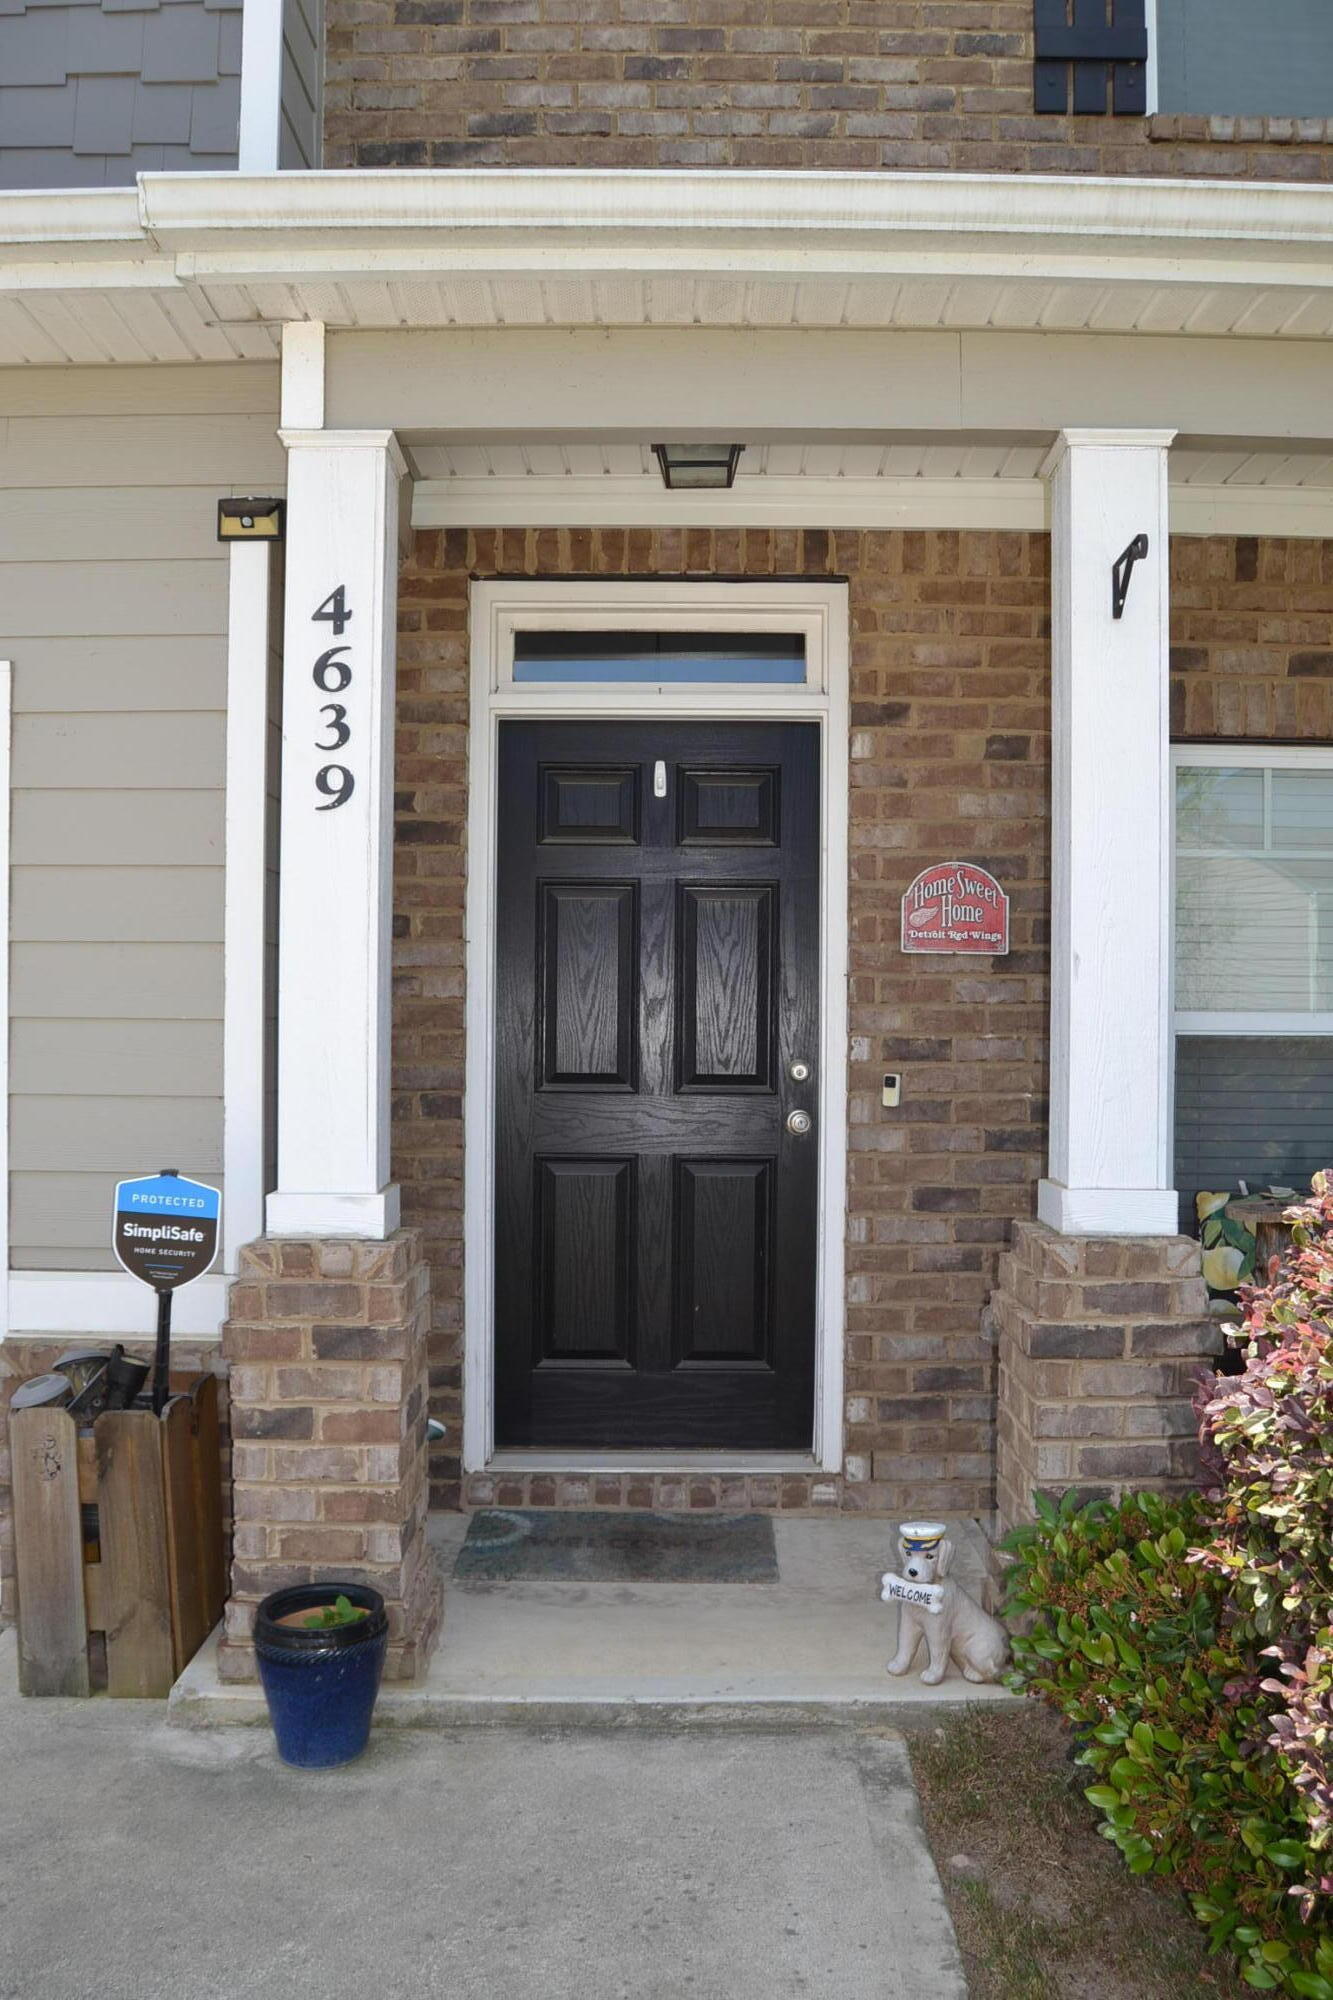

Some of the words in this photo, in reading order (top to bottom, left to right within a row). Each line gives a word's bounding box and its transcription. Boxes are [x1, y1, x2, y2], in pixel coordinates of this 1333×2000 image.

[311, 584, 355, 811] 4639
[914, 877, 955, 909] Home
[956, 870, 998, 909] Sweet
[941, 894, 983, 927] Home
[908, 930, 945, 939] Detroit
[947, 930, 968, 940] Red
[969, 931, 1002, 941] Wings
[132, 1193, 205, 1208] PROTECTED
[123, 1223, 204, 1242] SimpliSafe
[134, 1247, 156, 1255] HOME
[158, 1248, 196, 1257] SECURITY
[889, 1584, 932, 1605] WELCOME
